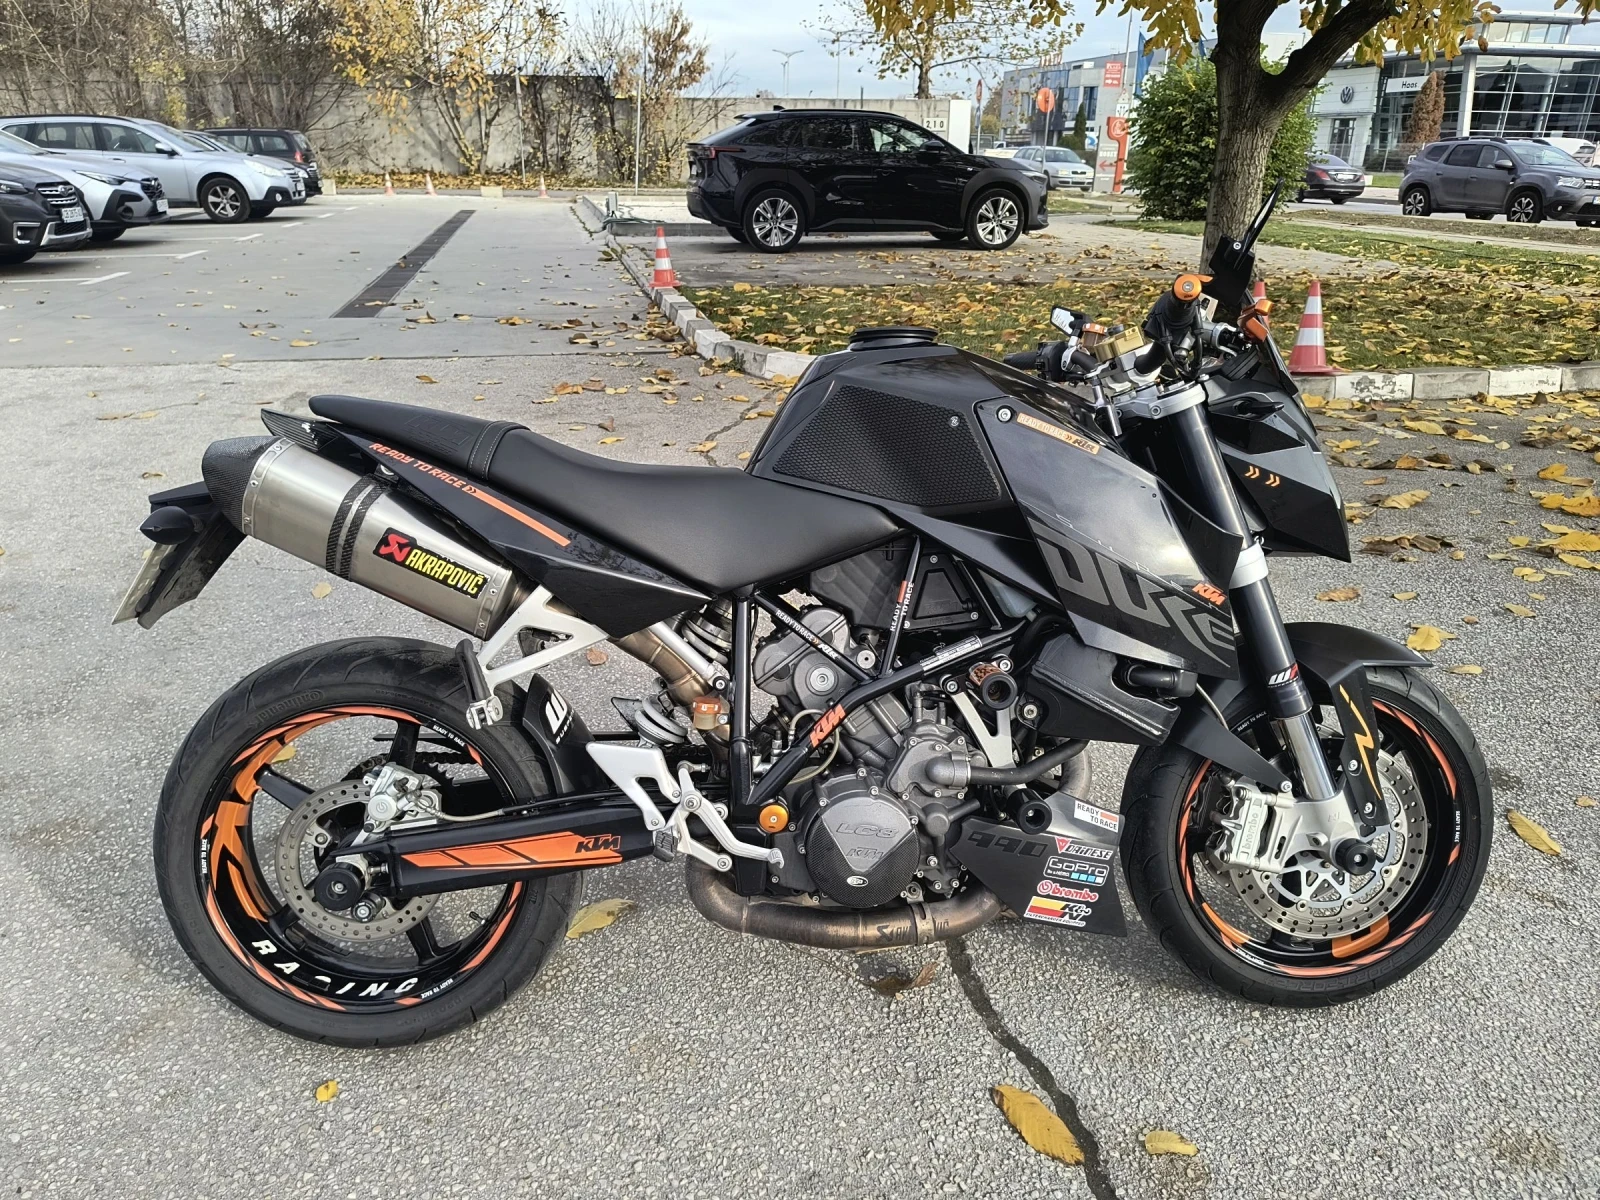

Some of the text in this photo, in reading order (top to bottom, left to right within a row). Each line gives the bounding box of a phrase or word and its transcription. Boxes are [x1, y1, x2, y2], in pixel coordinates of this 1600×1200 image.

[926, 120, 944, 129] 210
[1019, 414, 1042, 429] READY
[1050, 425, 1067, 439] RACE
[368, 442, 466, 490] READY TO RACE
[901, 582, 914, 616] TO RACE
[1027, 516, 1236, 668] DUKE
[1192, 582, 1227, 606] KTM
[776, 609, 794, 626] READY
[799, 627, 814, 642] RACE
[889, 604, 902, 632] READY
[809, 703, 846, 748] KTM
[1077, 803, 1100, 815] READY
[836, 822, 899, 840] LC8
[1089, 815, 1118, 831] TO RACE
[1242, 813, 1259, 850] brembo
[575, 834, 621, 854] KTM
[845, 847, 884, 859] KTM
[967, 830, 1049, 858] 990
[1048, 858, 1107, 876] GoPro
[1052, 882, 1098, 900] brembo
